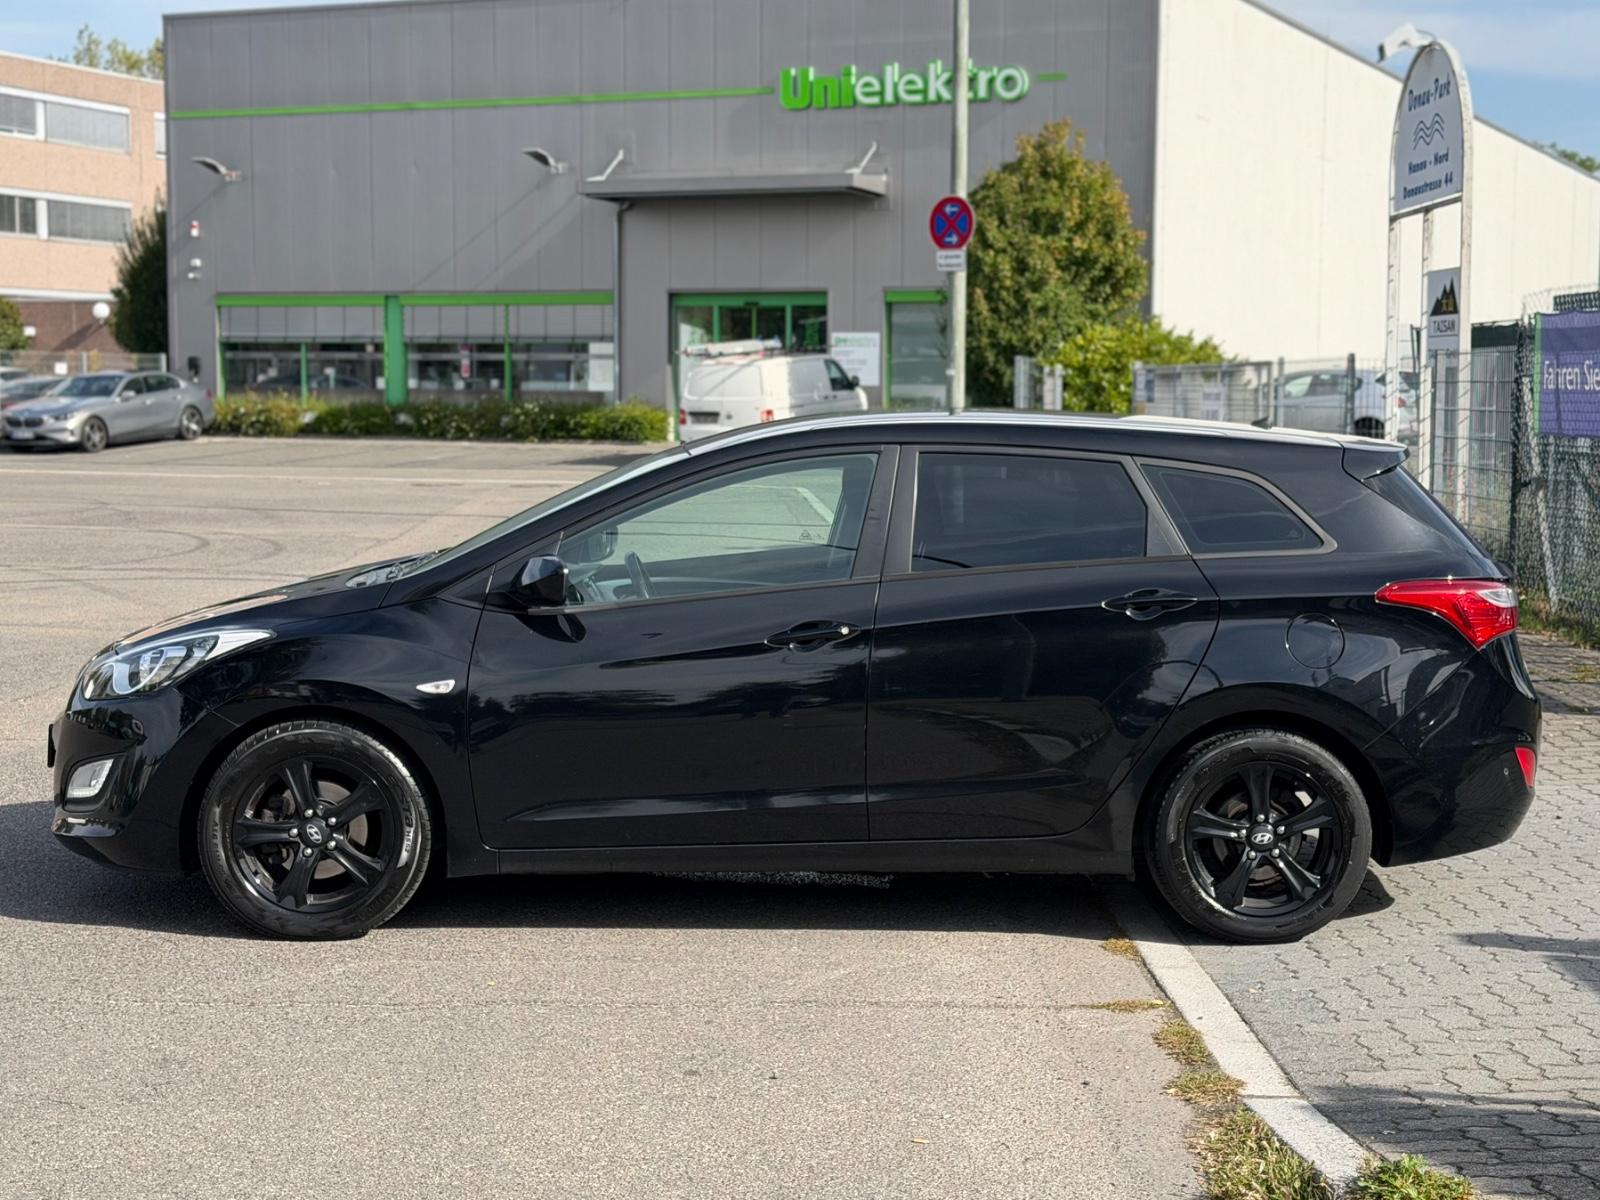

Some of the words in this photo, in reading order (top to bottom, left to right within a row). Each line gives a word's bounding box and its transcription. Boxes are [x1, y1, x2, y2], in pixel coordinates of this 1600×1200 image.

[1408, 76, 1451, 112] Donau-Park
[1408, 158, 1427, 175] Hanau
[1433, 147, 1449, 166] Nord
[1444, 171, 1453, 186] 44
[1543, 361, 1580, 390] Fahren
